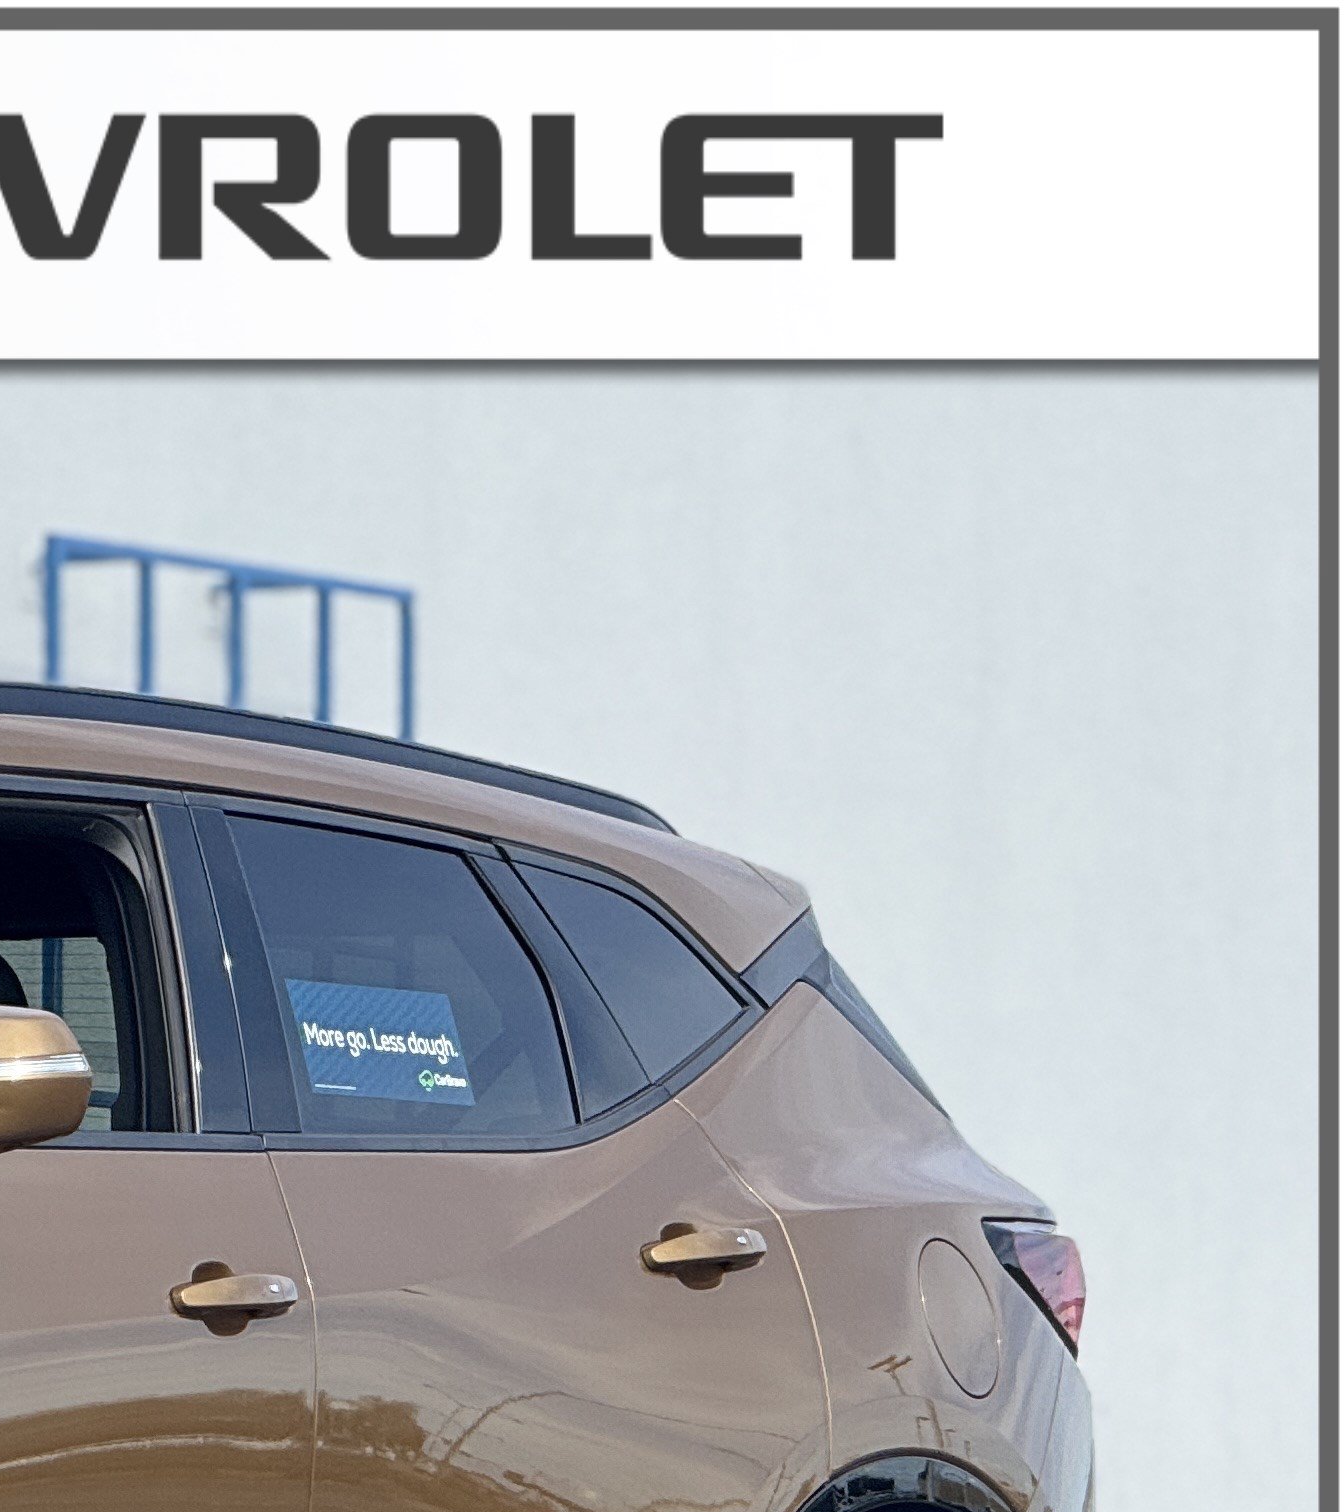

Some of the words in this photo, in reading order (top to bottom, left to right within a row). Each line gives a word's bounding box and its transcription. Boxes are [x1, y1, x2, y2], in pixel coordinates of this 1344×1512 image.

[303, 1021, 345, 1048] More
[347, 1030, 370, 1057] go.
[370, 1028, 406, 1053] Less
[408, 1031, 459, 1065] dough.
